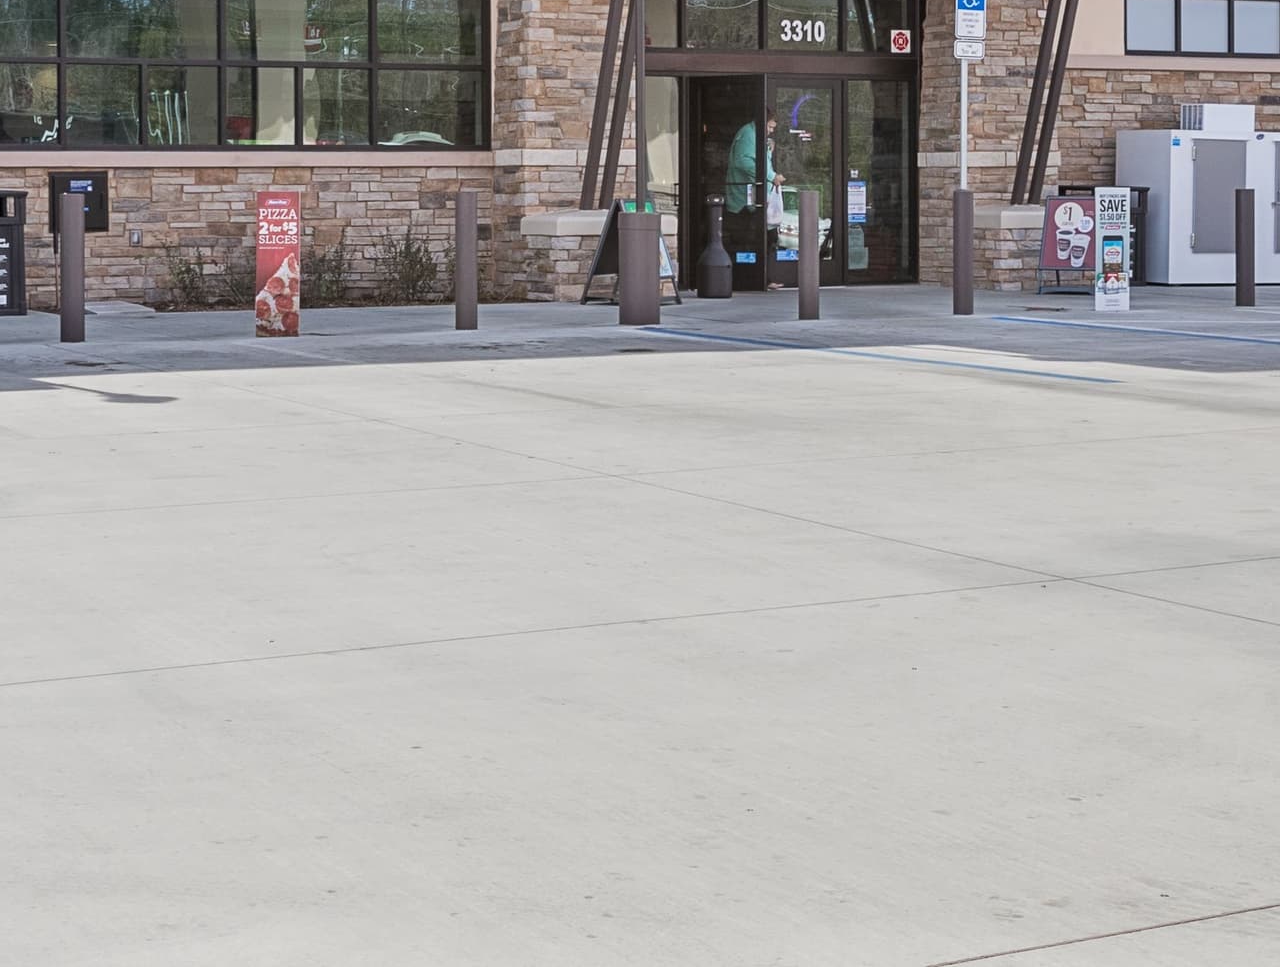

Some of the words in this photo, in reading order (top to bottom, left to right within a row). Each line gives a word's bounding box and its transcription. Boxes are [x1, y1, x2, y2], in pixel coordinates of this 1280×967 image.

[780, 19, 826, 42] 3310
[1100, 199, 1127, 213] SAVE
[259, 208, 297, 219] PIZZA
[1063, 206, 1073, 221] $1
[1100, 213, 1115, 221] $1.50
[1116, 213, 1126, 221] OFF
[259, 222, 269, 234] 2
[269, 224, 281, 232] for
[282, 222, 297, 235] $5
[259, 235, 297, 244] SLICES
